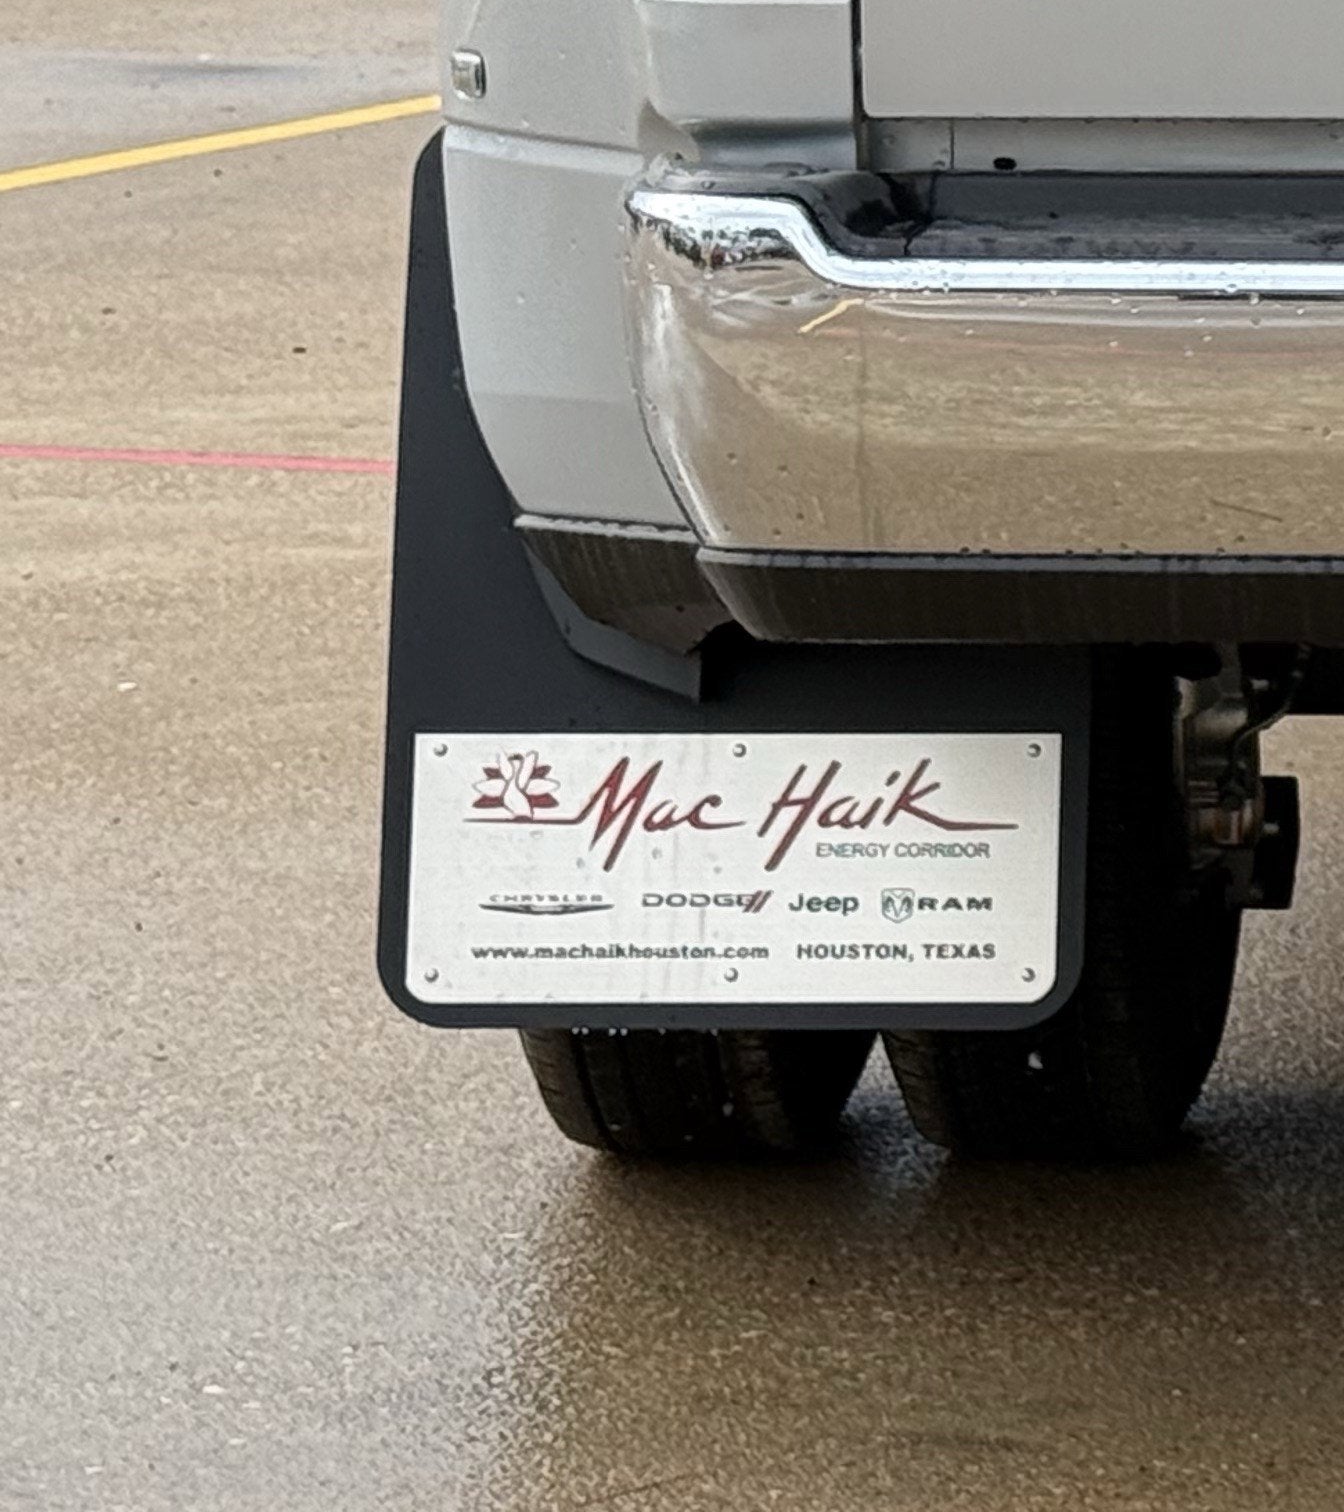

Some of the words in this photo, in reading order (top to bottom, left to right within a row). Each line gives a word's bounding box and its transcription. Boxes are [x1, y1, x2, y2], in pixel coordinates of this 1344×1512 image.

[575, 755, 747, 872] Mac
[757, 758, 1018, 872] Haik
[816, 842, 889, 859] ENERGY
[893, 842, 990, 859] CORRIDOR
[642, 893, 755, 908] DODGE
[789, 892, 860, 915] Jeep
[917, 896, 993, 912] RAM
[471, 943, 770, 960] www.machaikhouston.com
[796, 943, 915, 963] HOUSTON,
[921, 943, 996, 960] TEXAS
